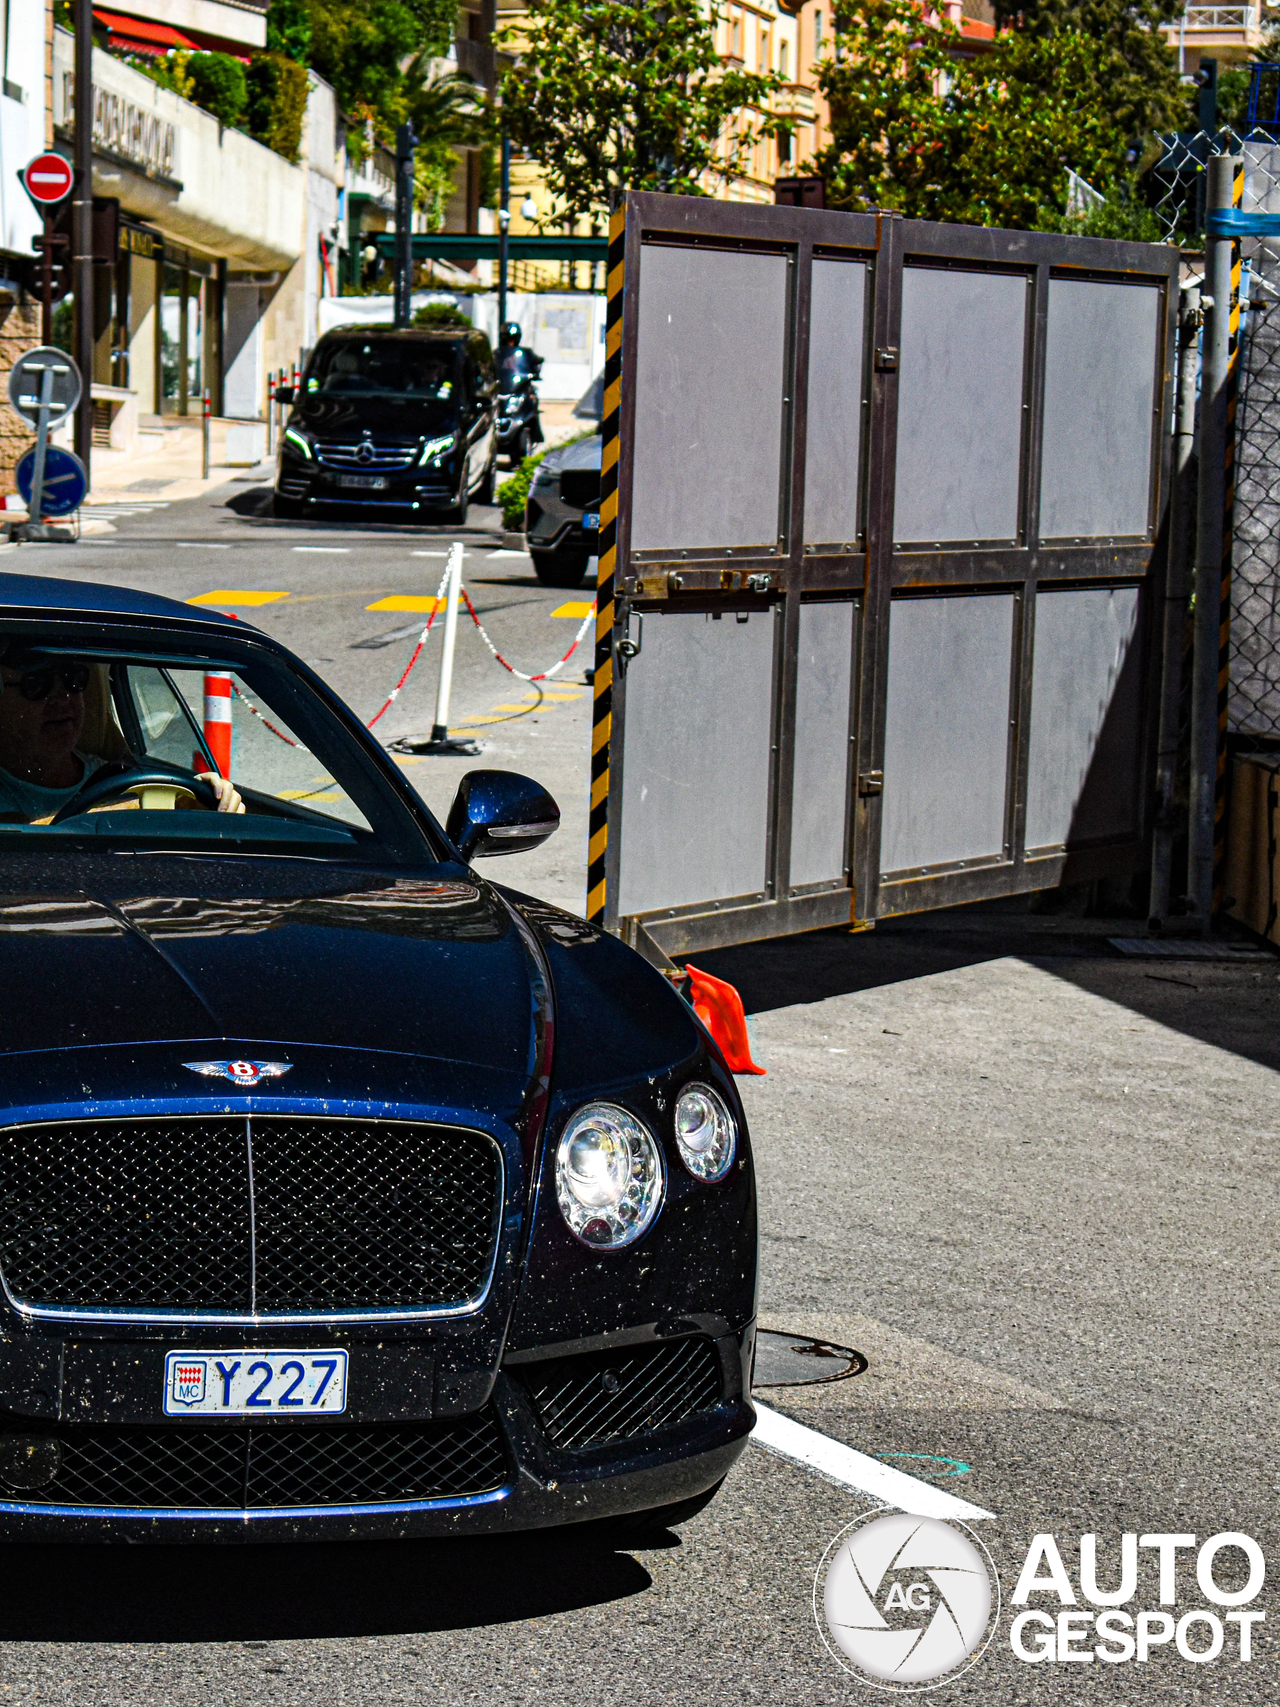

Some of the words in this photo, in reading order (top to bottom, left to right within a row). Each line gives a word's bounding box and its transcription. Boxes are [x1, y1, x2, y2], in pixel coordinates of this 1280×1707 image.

[233, 1060, 254, 1077] B
[179, 1385, 200, 1398] MC
[215, 1359, 338, 1407] Y227
